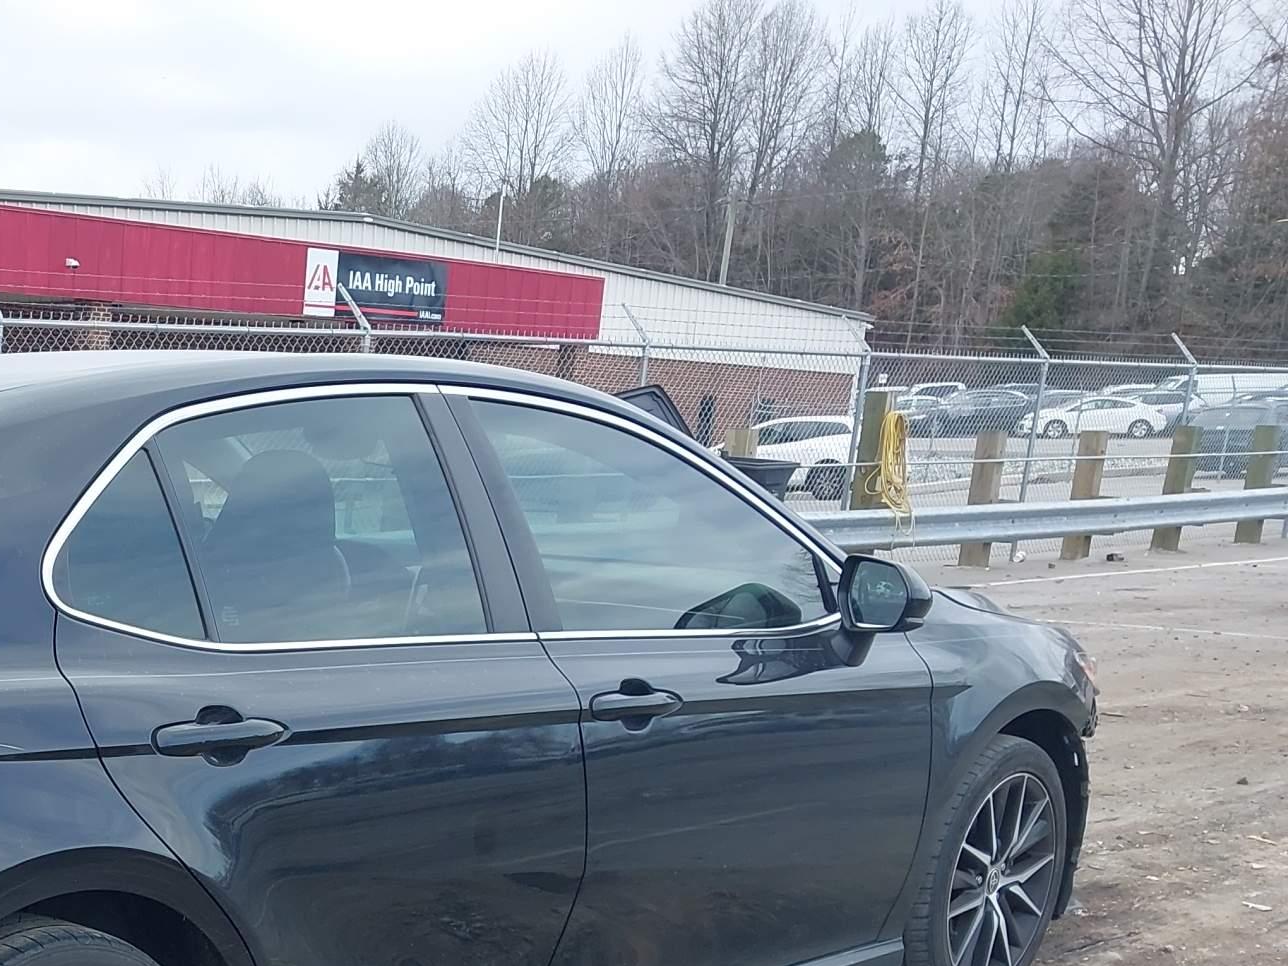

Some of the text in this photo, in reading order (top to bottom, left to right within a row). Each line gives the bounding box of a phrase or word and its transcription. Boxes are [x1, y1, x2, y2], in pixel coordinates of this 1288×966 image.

[349, 270, 436, 297] IAA High Point
